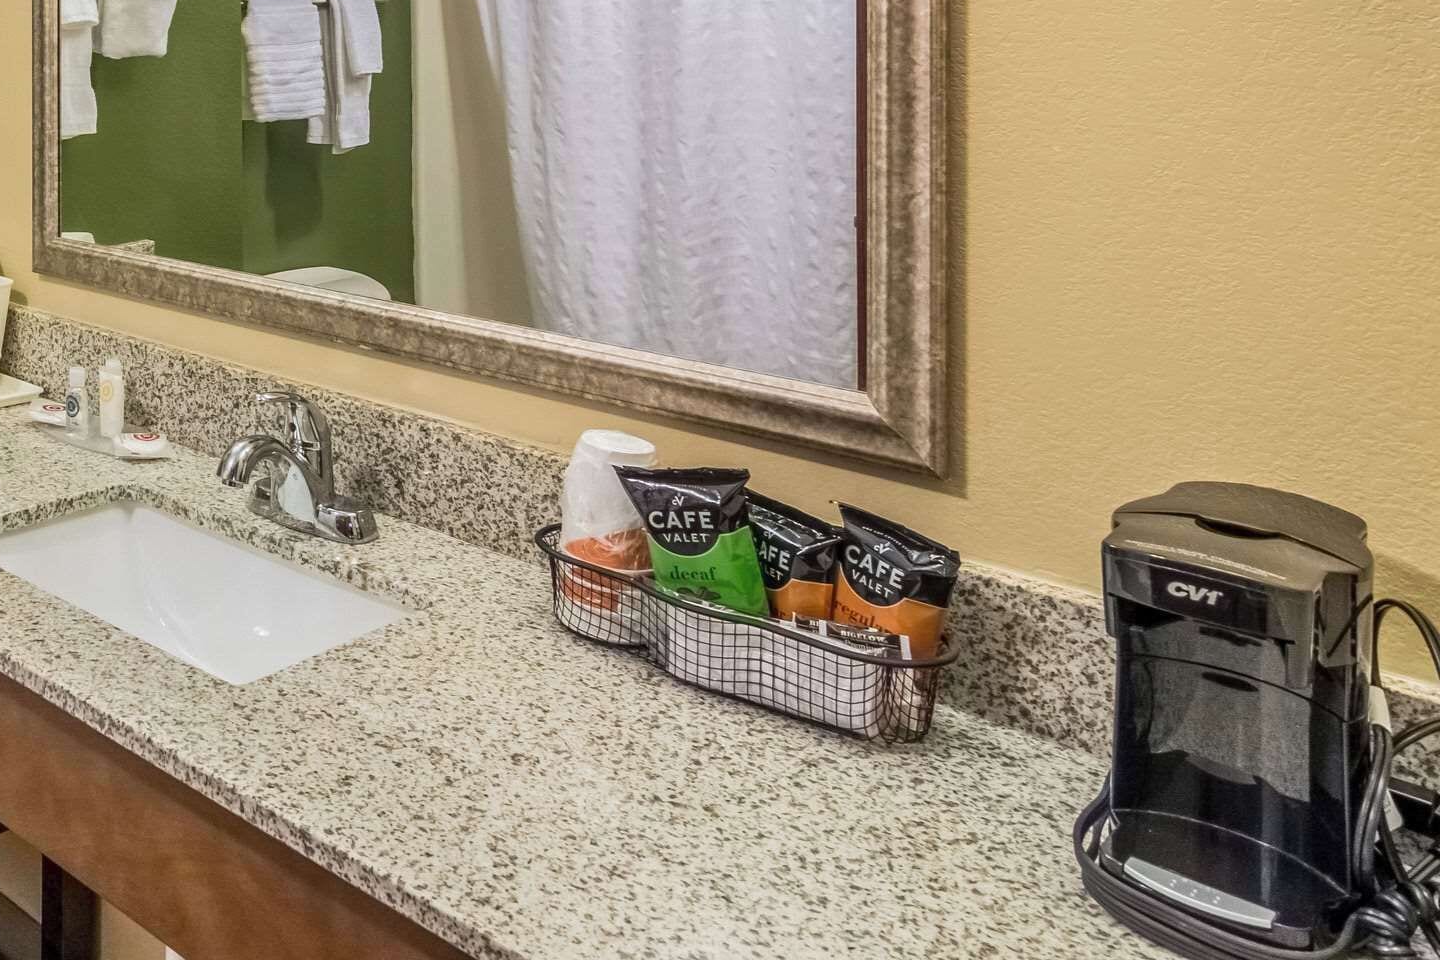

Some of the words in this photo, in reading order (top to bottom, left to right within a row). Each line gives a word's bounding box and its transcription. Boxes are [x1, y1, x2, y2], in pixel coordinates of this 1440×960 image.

[663, 533, 709, 543] VALET
[669, 565, 716, 581] decaf
[852, 569, 894, 598] VALET
